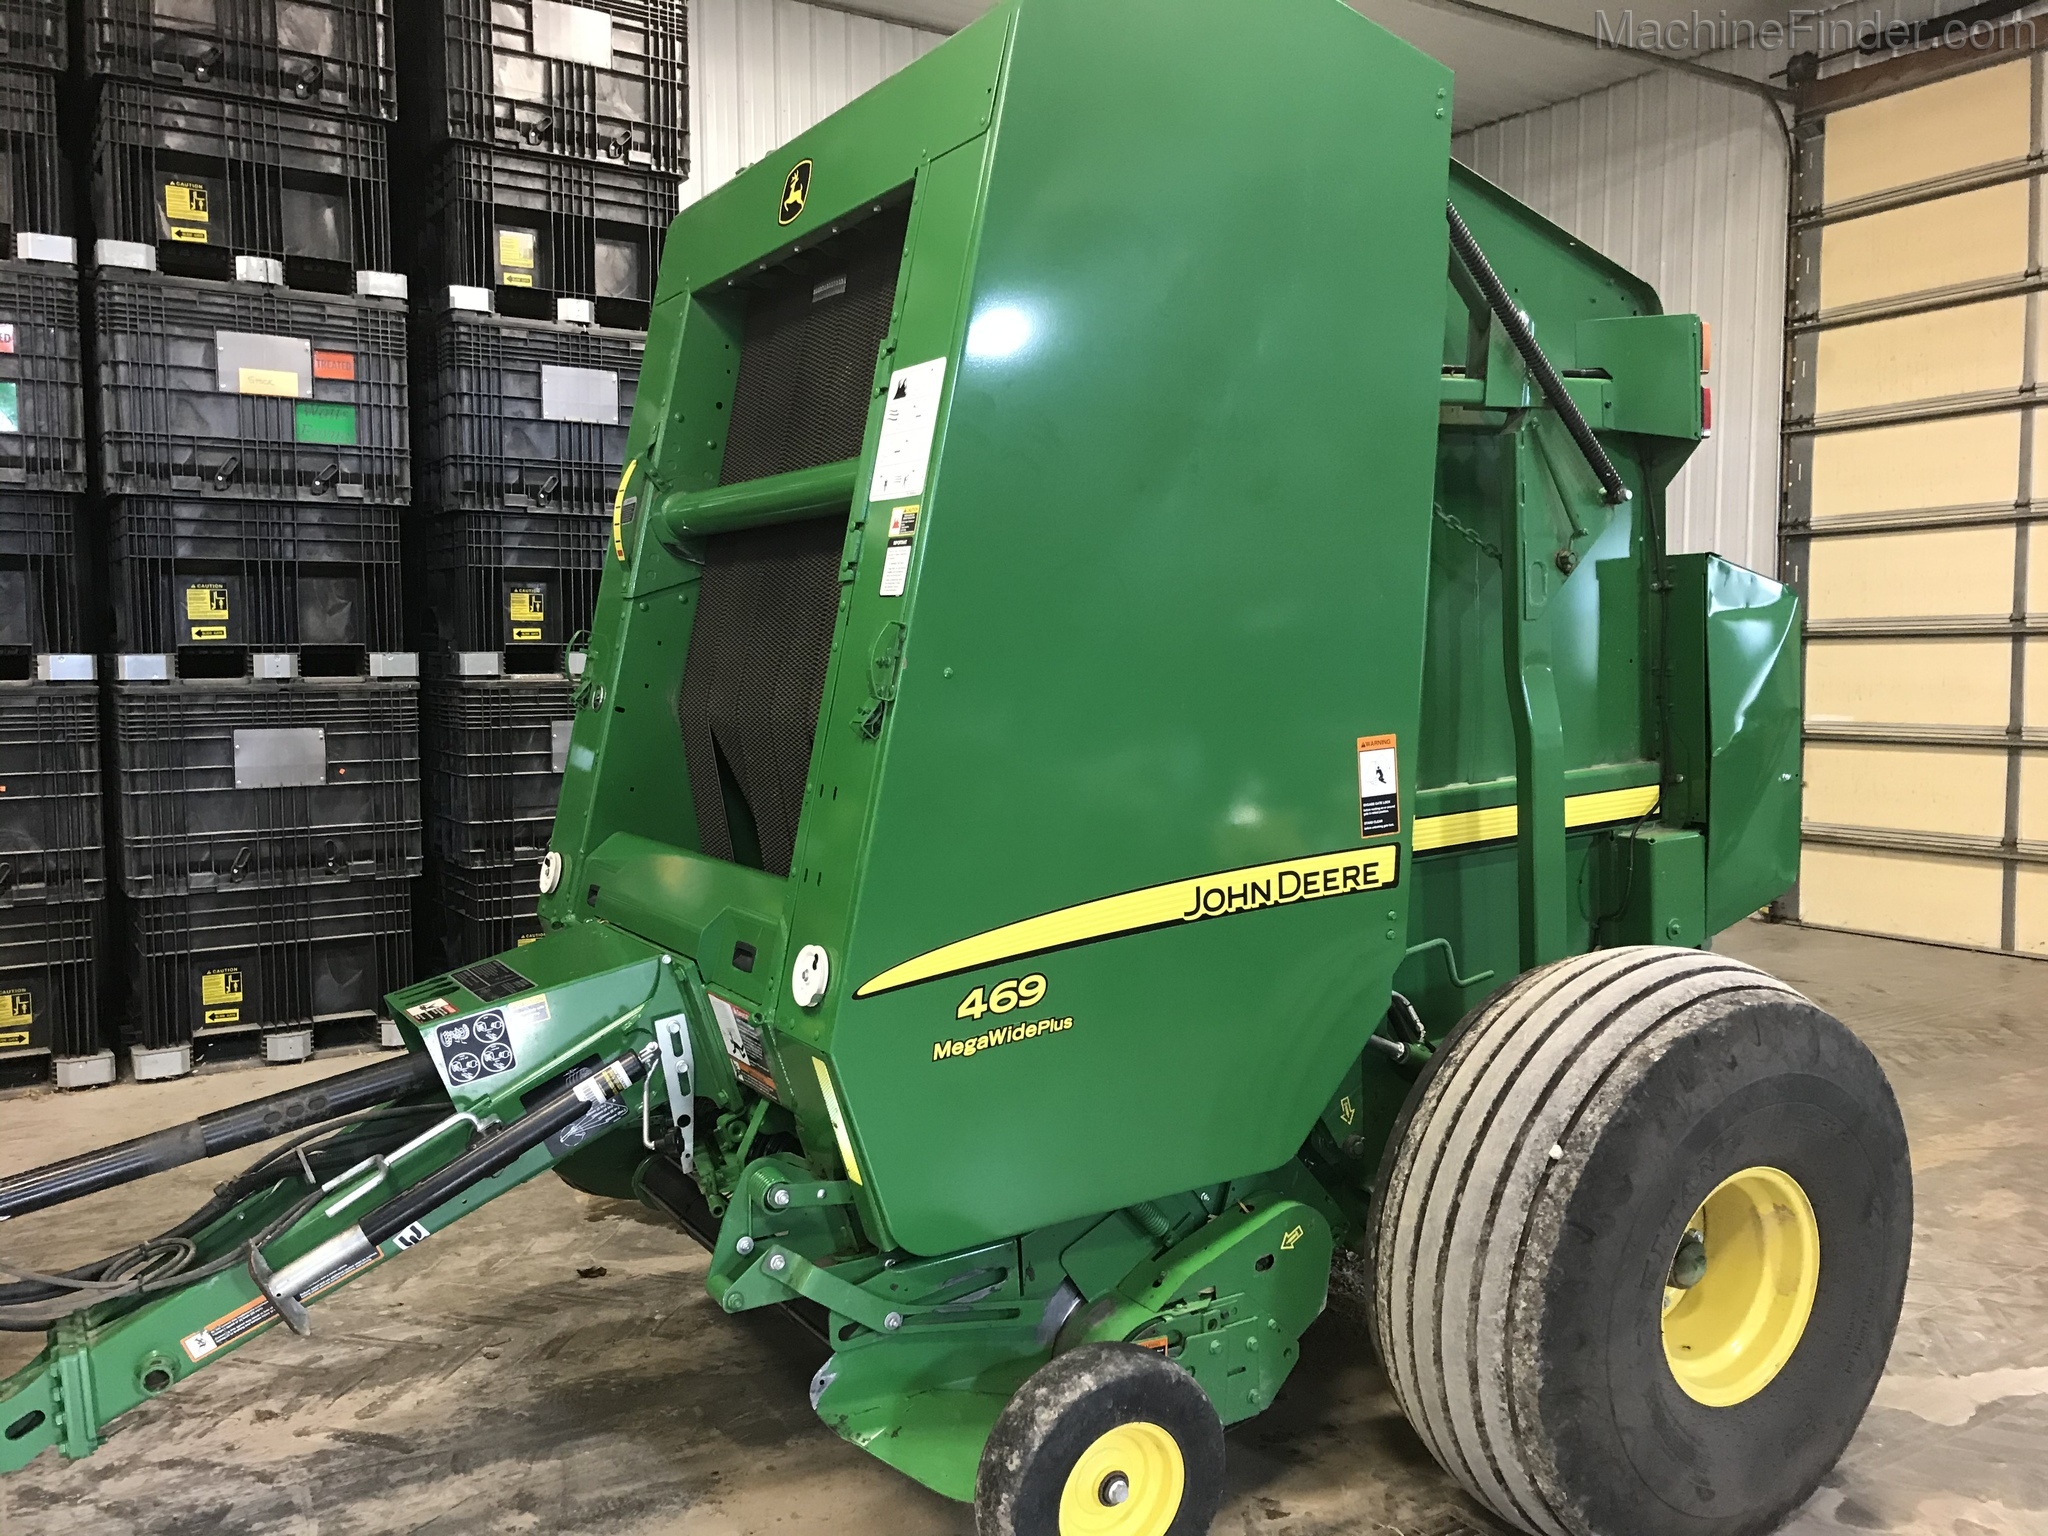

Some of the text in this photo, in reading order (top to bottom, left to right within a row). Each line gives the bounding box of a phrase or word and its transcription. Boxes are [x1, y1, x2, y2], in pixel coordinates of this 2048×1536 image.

[176, 181, 203, 189] CAUTION
[316, 359, 351, 371] TREATED
[1365, 738, 1391, 747] WARNING
[1184, 862, 1379, 917] JOHN DEERE
[956, 972, 1048, 1021] 469
[932, 1016, 1074, 1062] MegaWidePlus
